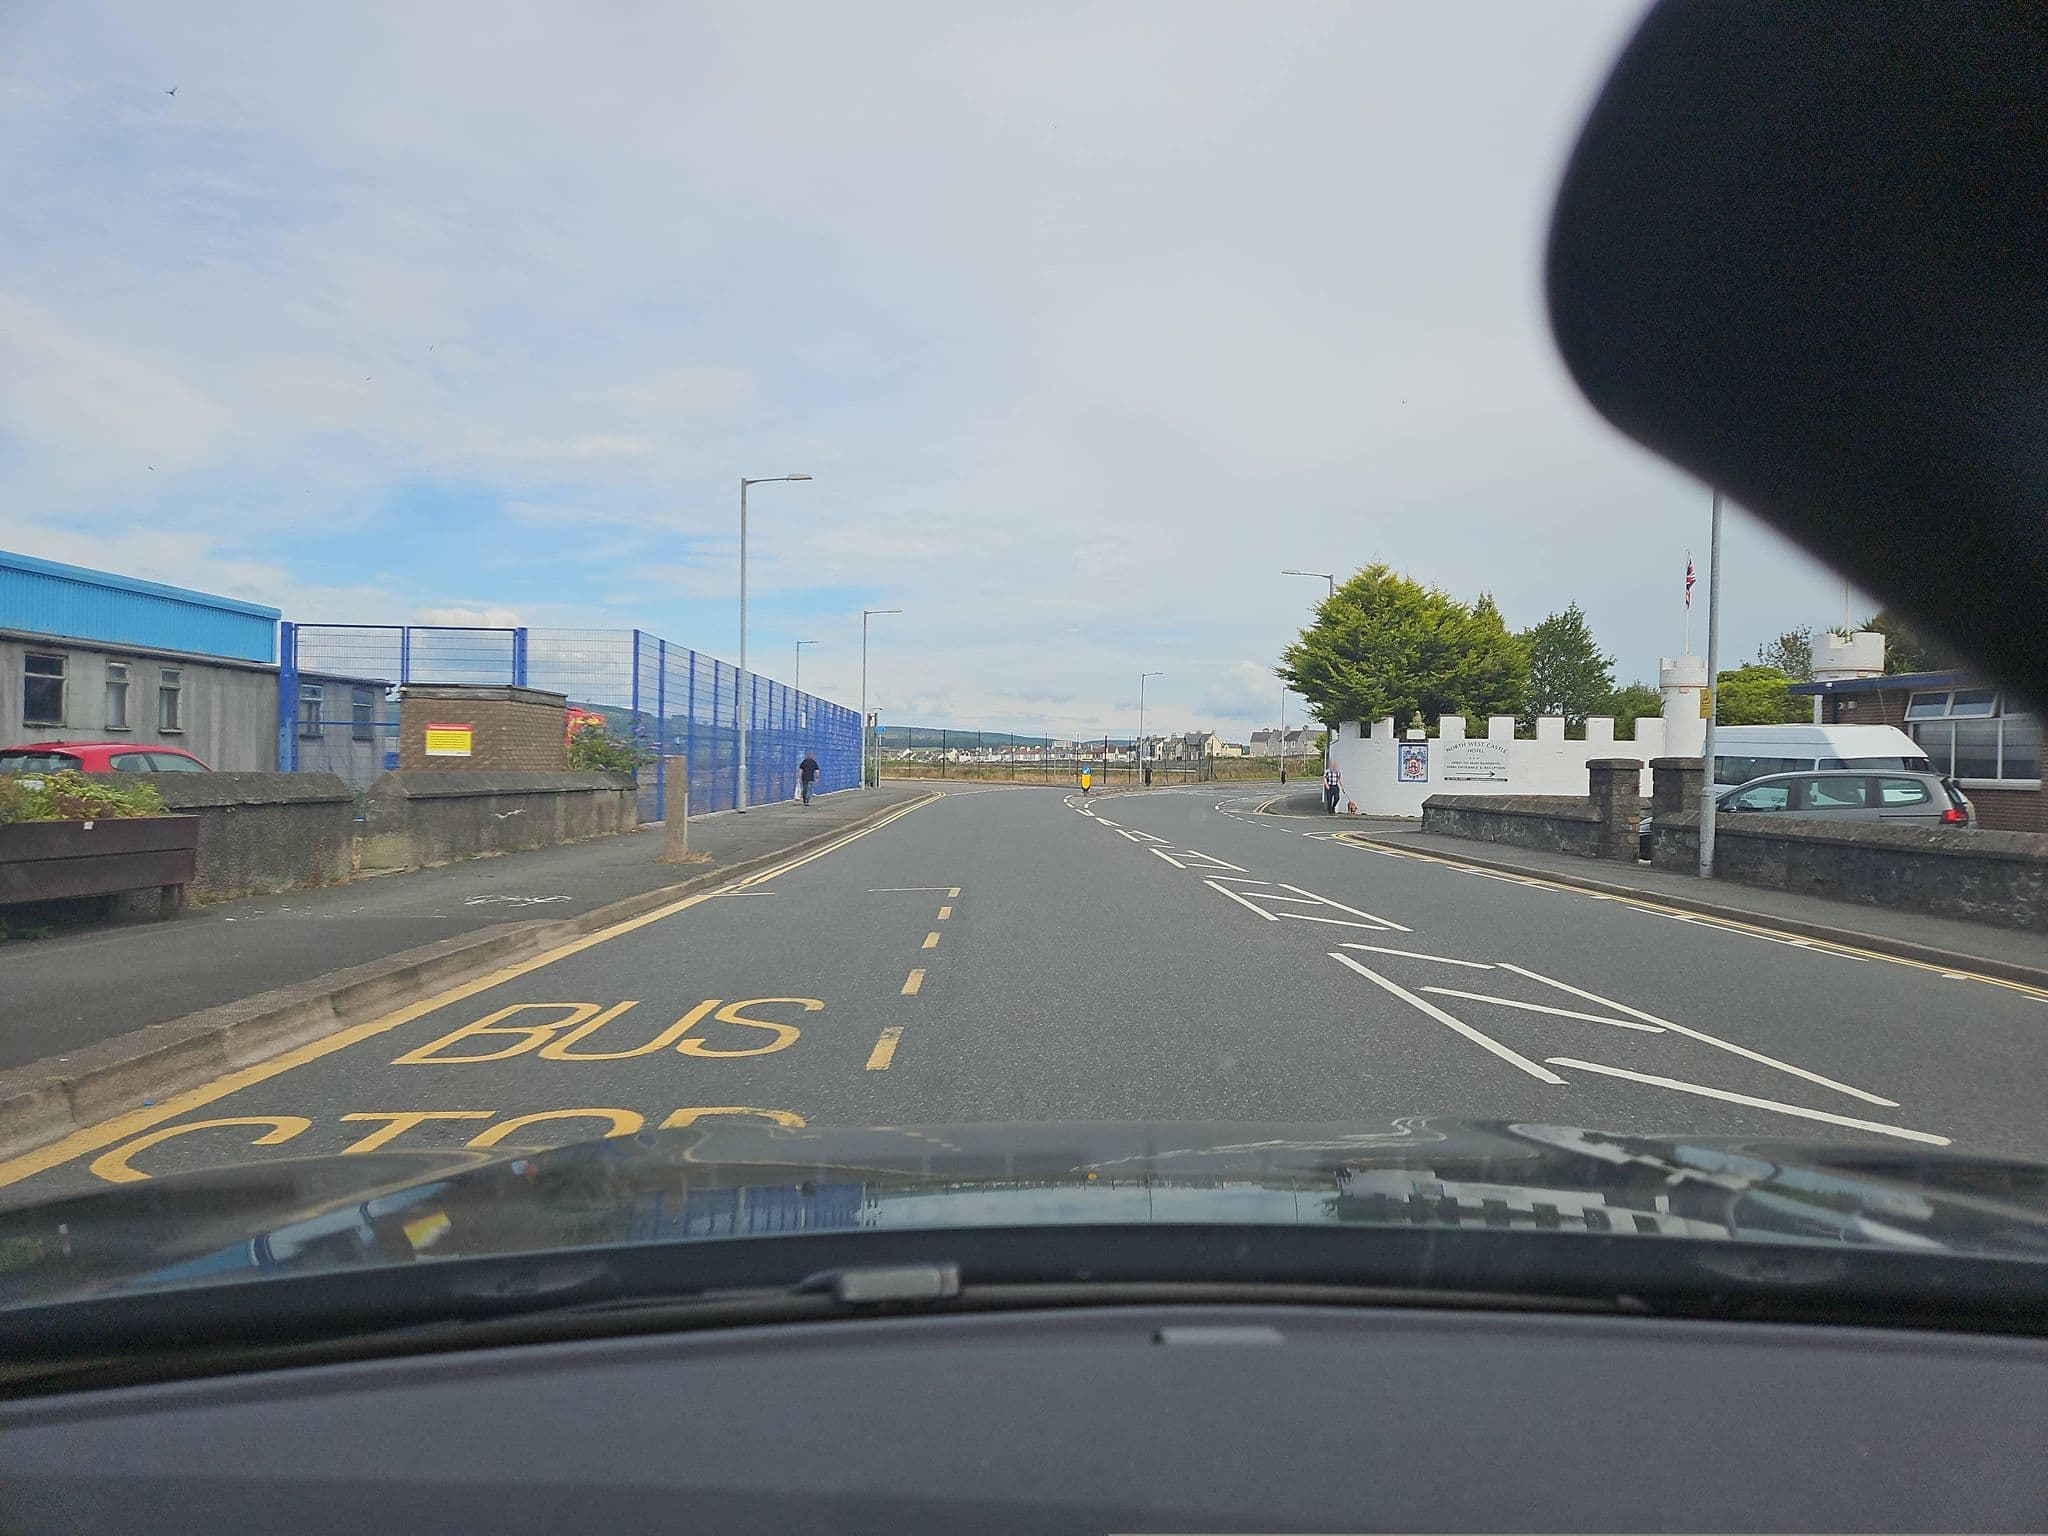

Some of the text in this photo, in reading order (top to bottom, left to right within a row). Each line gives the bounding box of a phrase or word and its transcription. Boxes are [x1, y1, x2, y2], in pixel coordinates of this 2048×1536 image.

[1446, 742, 1467, 753] NORTH
[1486, 742, 1507, 754] CASTLE
[390, 997, 825, 1066] BUS
